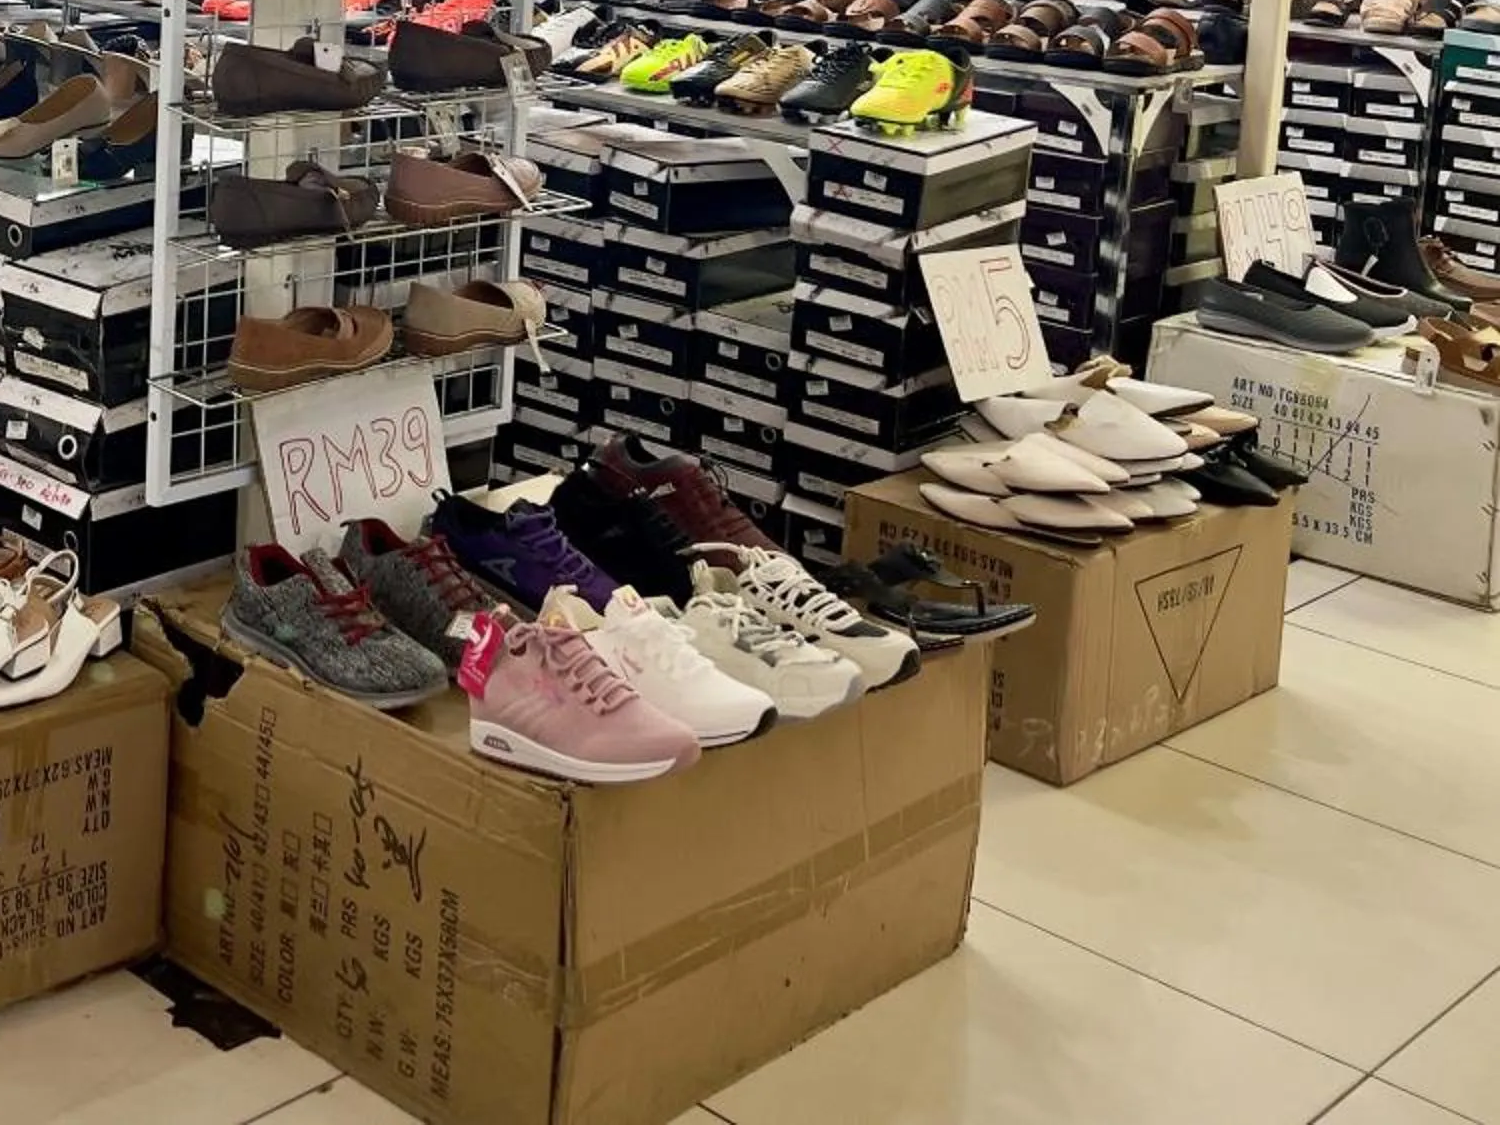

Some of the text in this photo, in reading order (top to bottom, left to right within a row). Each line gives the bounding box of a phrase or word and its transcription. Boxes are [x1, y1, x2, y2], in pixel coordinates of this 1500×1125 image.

[1232, 376, 1255, 394] ART
[1231, 394, 1254, 409] SIZE
[1328, 416, 1341, 430] 43
[1365, 426, 1380, 440] 45
[279, 406, 433, 535] RM39
[1351, 487, 1375, 504] PRS
[1350, 501, 1374, 518] KGS
[1350, 515, 1373, 531] KGS
[1355, 530, 1374, 545] CM
[256, 723, 274, 780] 44/45
[31, 832, 46, 855] 12
[17, 863, 26, 883] 2
[41, 855, 50, 875] 2
[57, 872, 73, 896] 36
[1, 881, 108, 938] COLOR BLACK
[15, 886, 31, 910] 38
[80, 904, 107, 931] ART
[340, 897, 357, 940] PRS
[219, 924, 235, 967] ART
[372, 914, 391, 963] KGS
[404, 930, 424, 980] KGS
